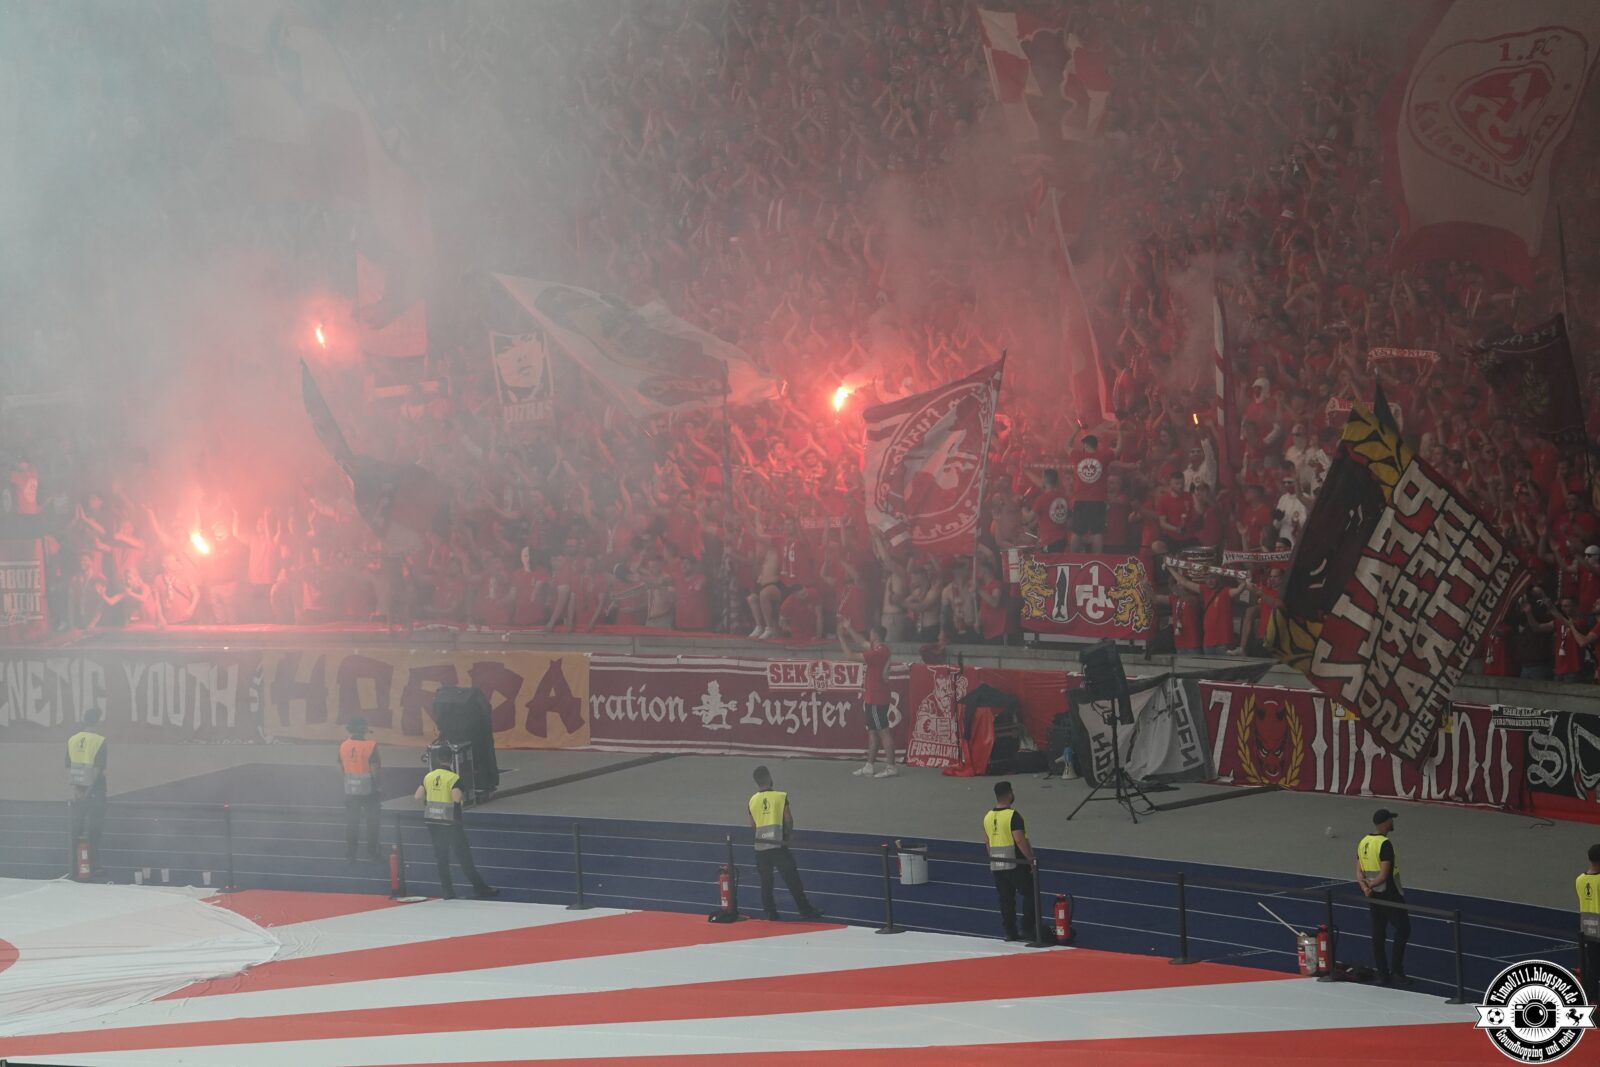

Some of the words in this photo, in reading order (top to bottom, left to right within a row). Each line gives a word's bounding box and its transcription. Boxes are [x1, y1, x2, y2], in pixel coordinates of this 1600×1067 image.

[122, 659, 240, 731] YOUTH
[769, 663, 808, 684] SEK
[834, 664, 860, 684] SV
[590, 683, 689, 724] ration
[740, 690, 853, 736] Luzifer
